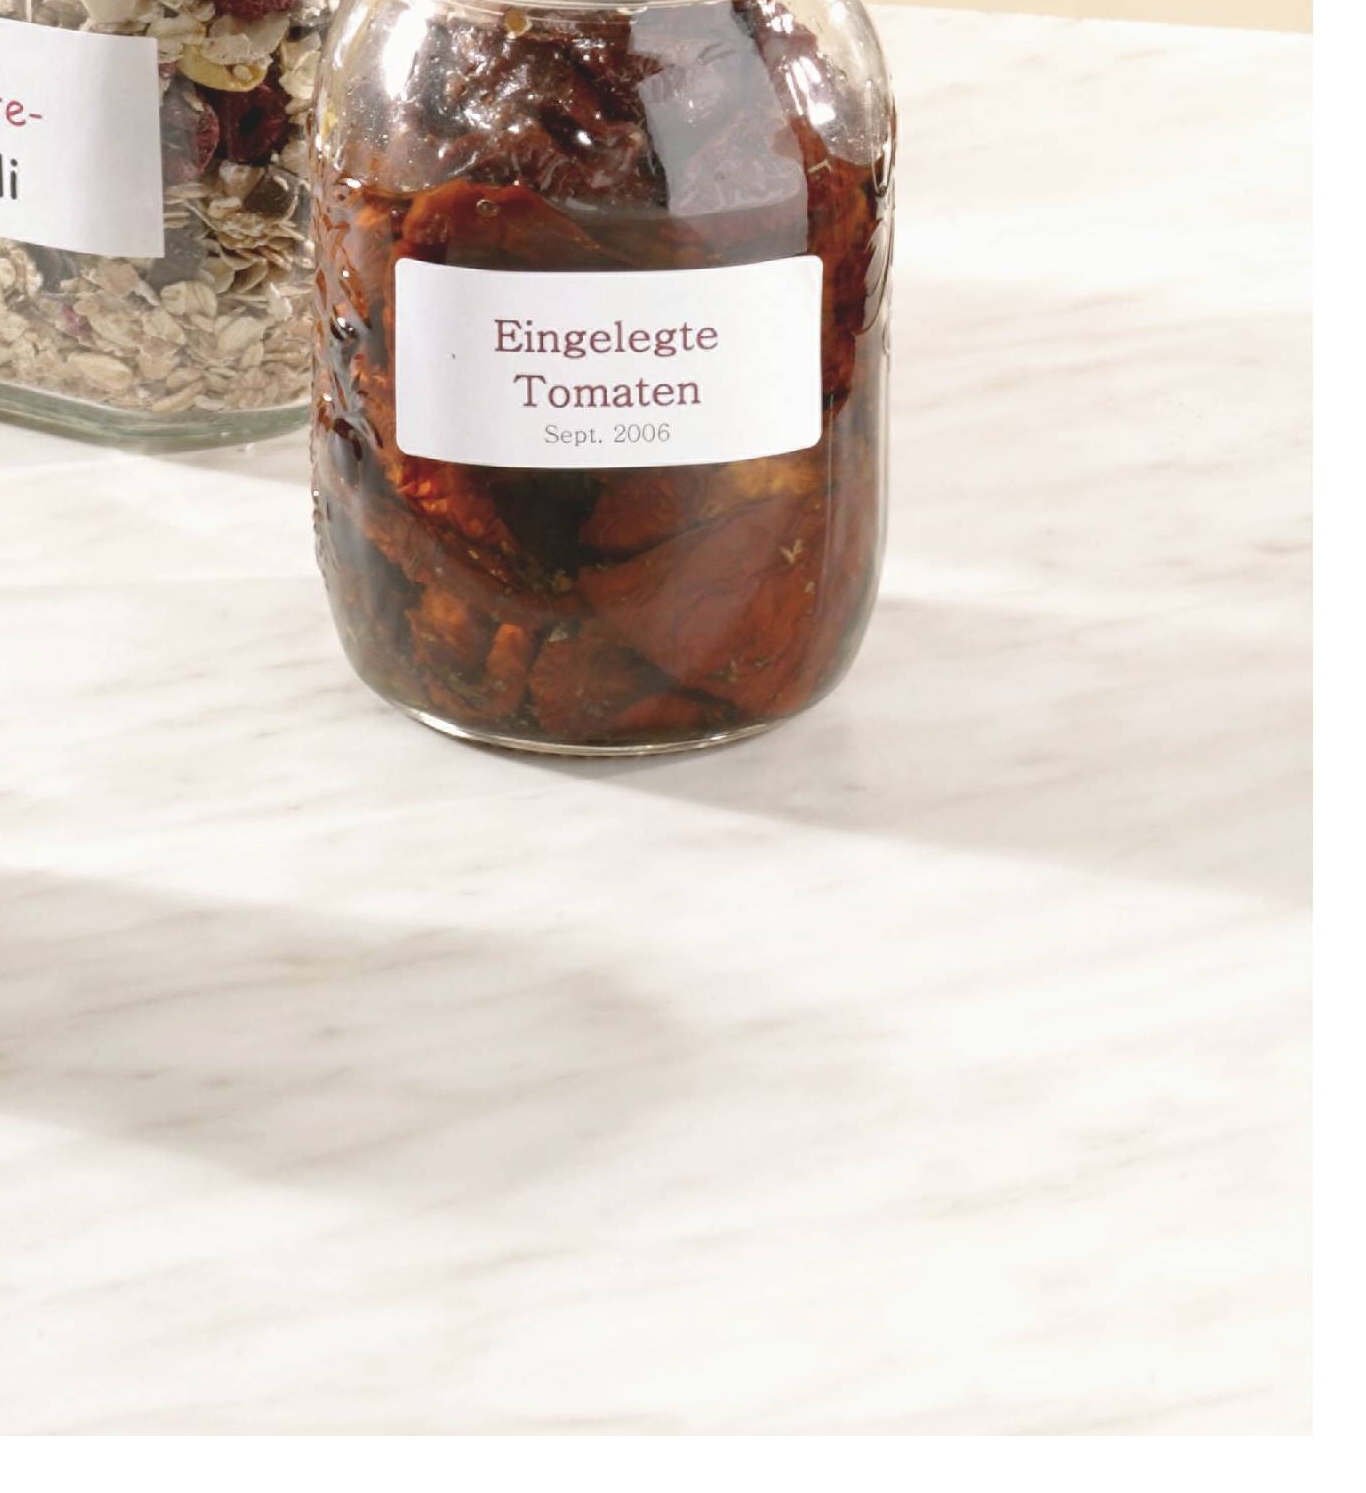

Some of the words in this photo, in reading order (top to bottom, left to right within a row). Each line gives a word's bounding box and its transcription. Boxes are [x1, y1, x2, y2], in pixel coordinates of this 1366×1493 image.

[494, 319, 719, 359] Eingelegte
[513, 374, 702, 409] Tomaten
[544, 423, 604, 447] Sept.
[613, 423, 671, 444] 2006
